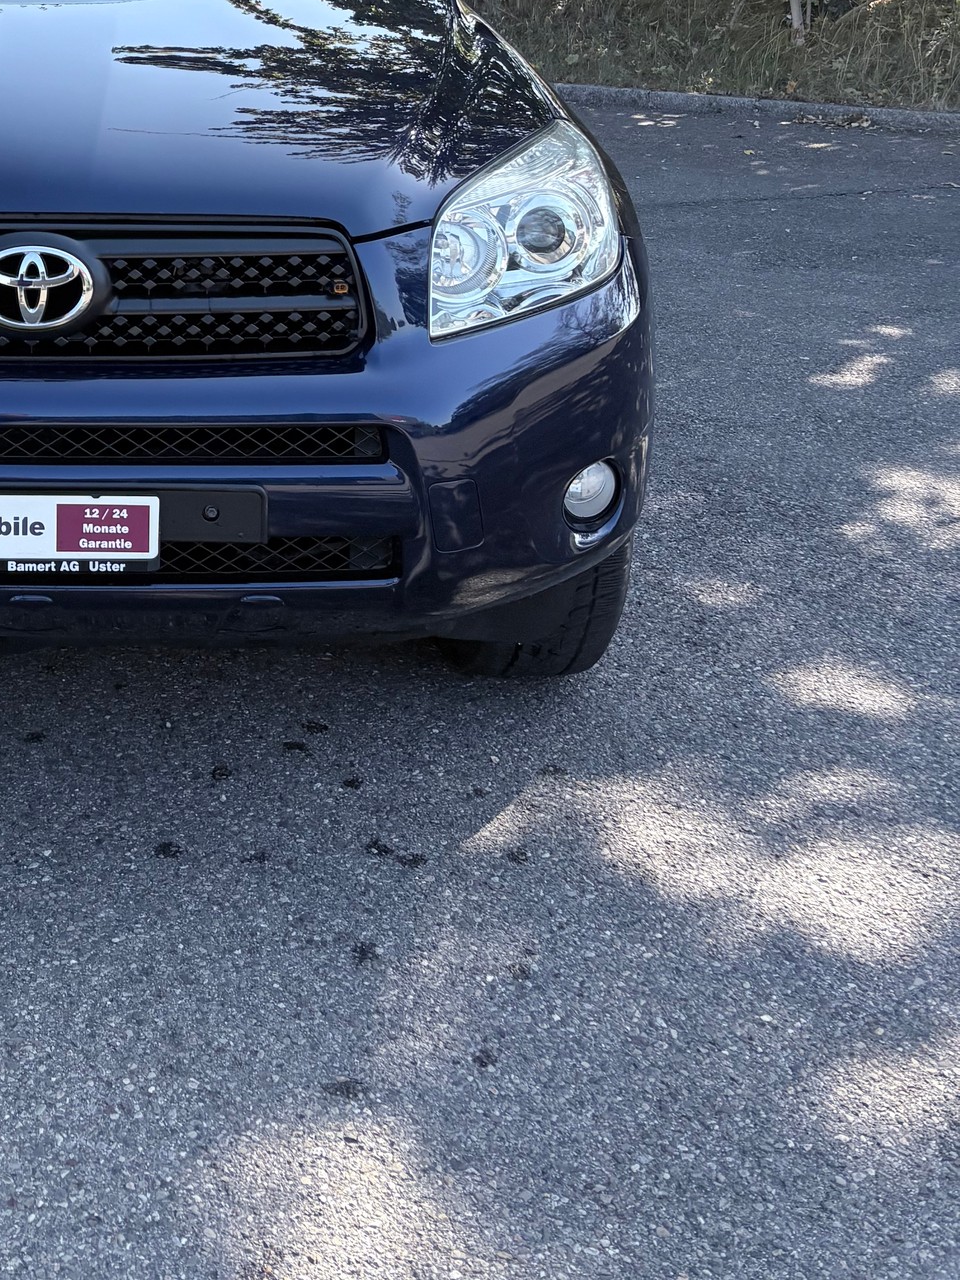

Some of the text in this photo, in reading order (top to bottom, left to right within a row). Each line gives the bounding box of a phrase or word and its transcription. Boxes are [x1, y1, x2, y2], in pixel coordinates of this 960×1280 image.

[84, 508, 128, 520] 12 / 24
[82, 523, 129, 534] Monate
[79, 538, 133, 549] Garantie
[7, 561, 56, 572] Bamert
[60, 561, 80, 572] AG
[89, 561, 126, 572] Uster
